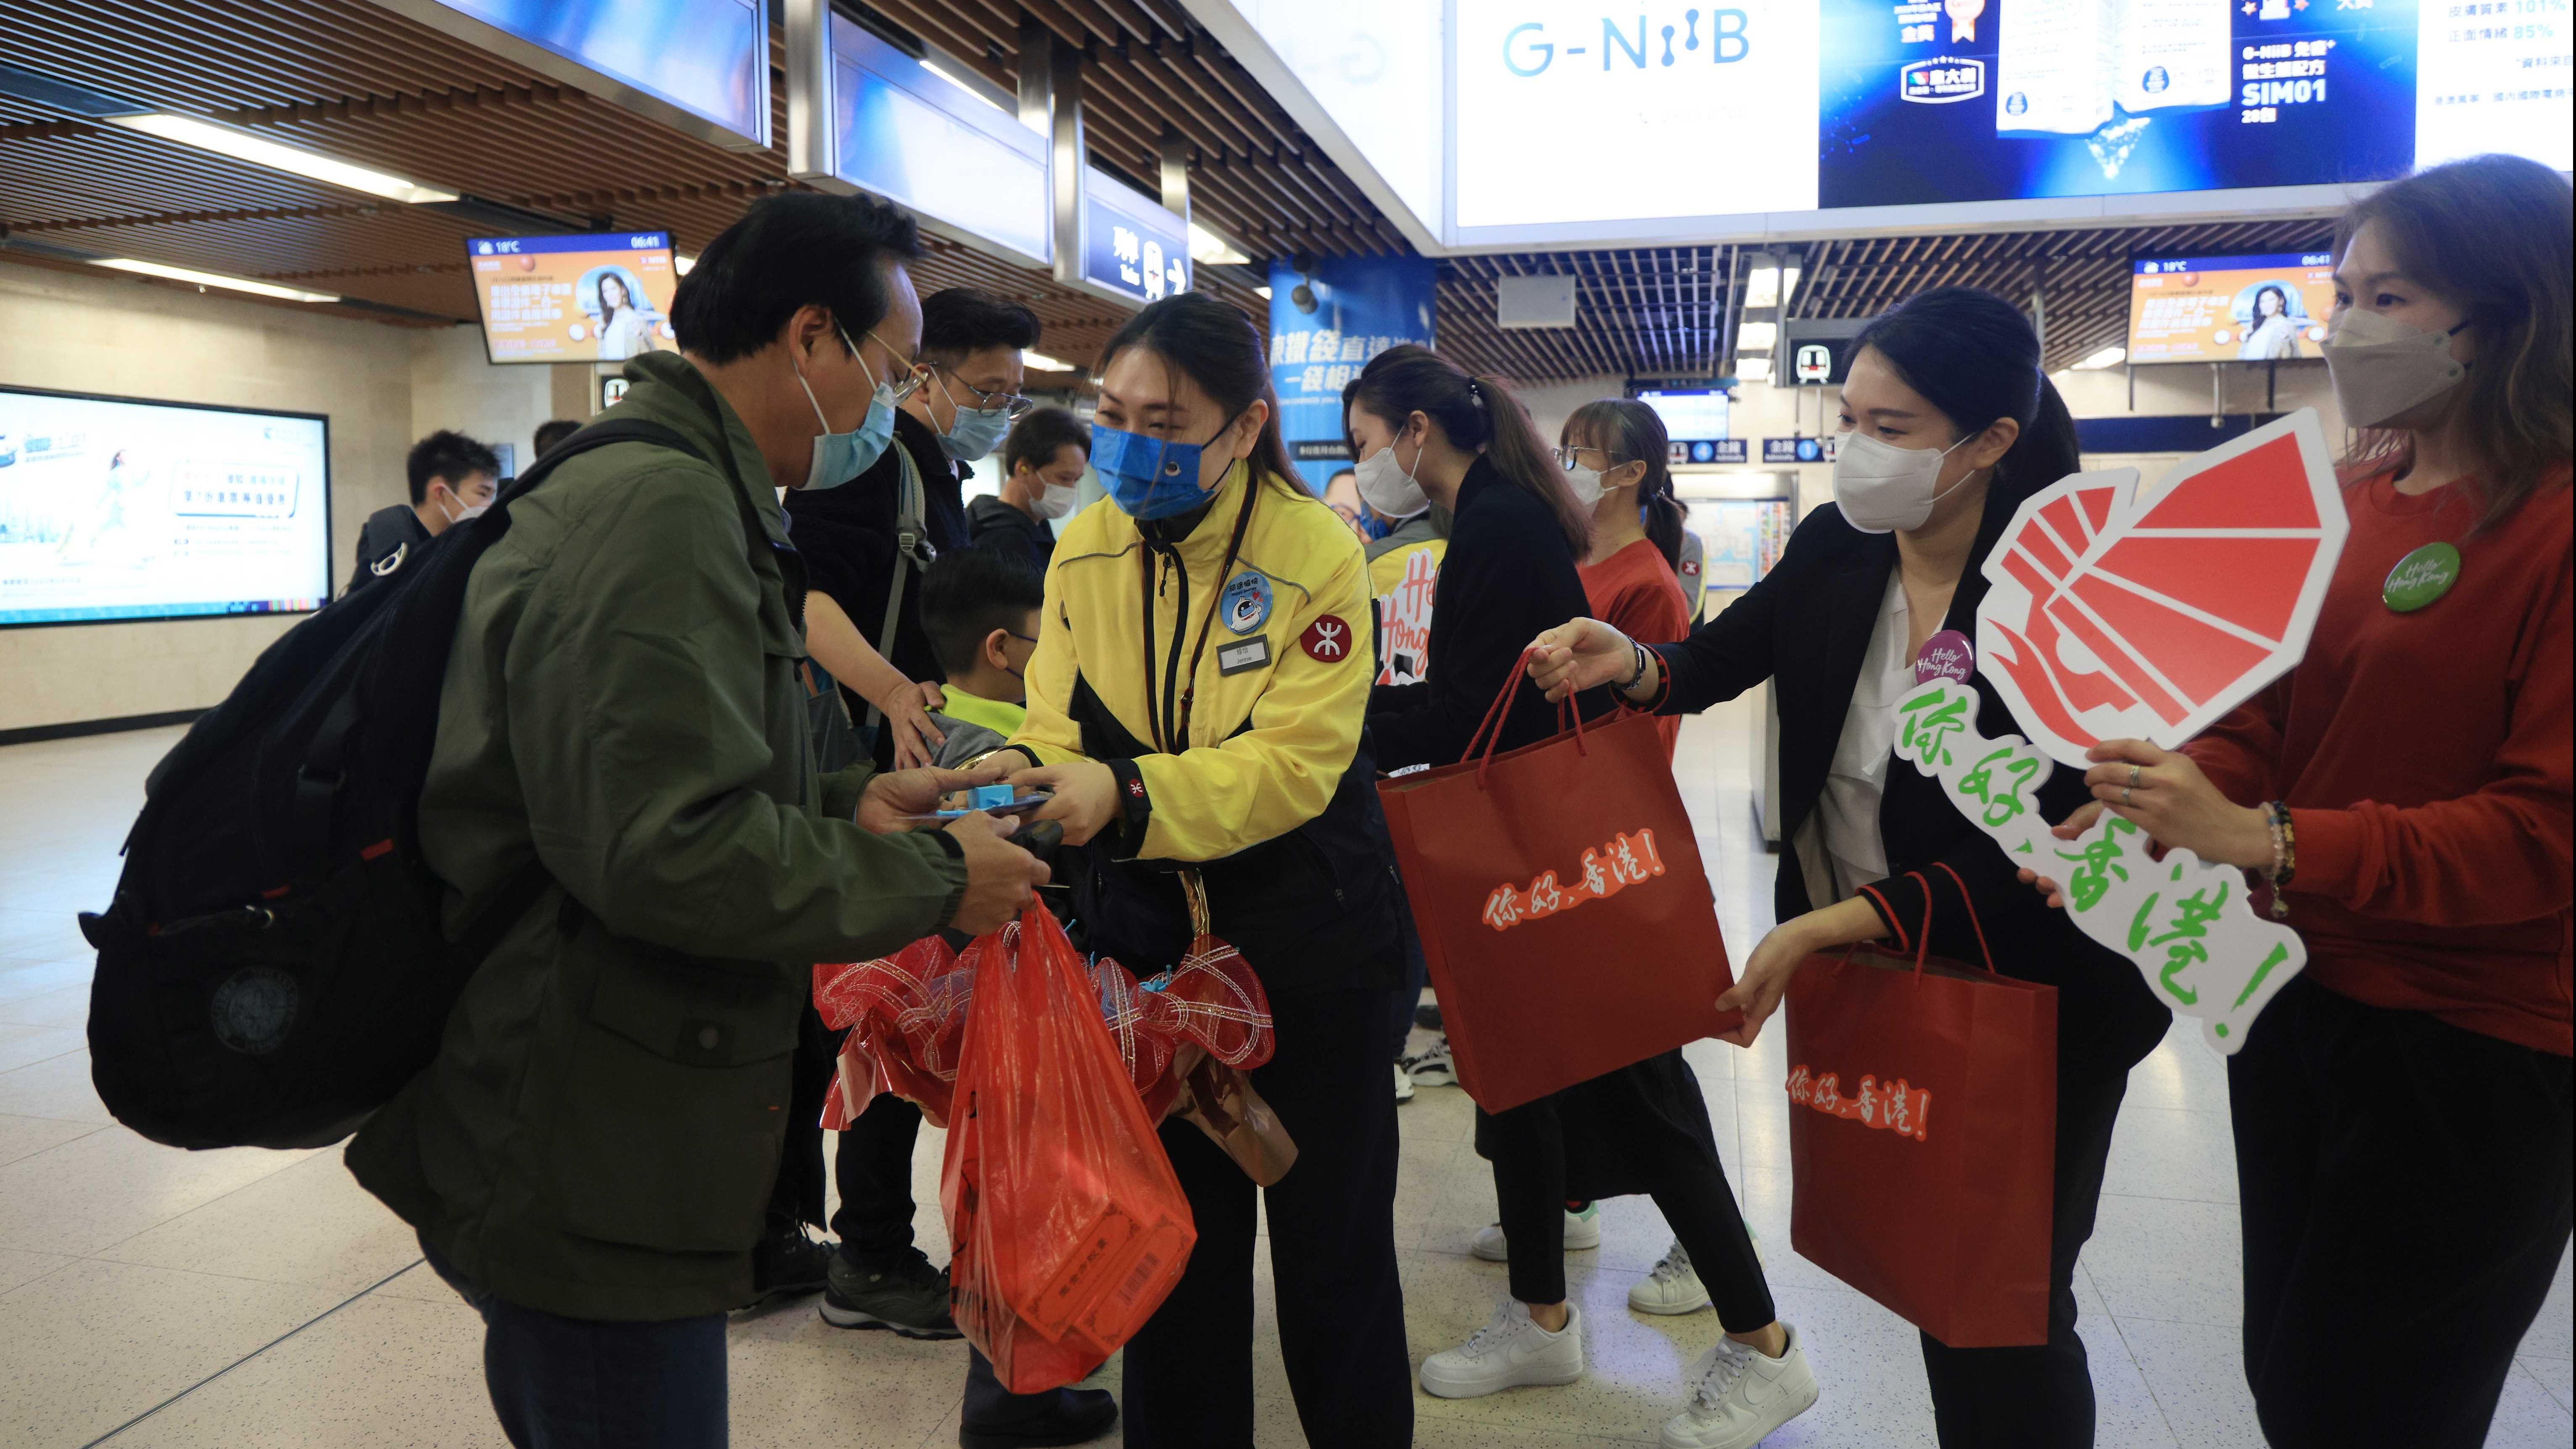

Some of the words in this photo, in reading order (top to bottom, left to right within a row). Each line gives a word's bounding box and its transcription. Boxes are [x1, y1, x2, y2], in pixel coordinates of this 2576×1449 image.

[2514, 24, 2554, 39] 85%
[2241, 79, 2326, 106] SIM01
[631, 236, 659, 249] 06:41
[1697, 445, 1708, 457] 4
[1804, 443, 1811, 456] 1
[2405, 559, 2445, 578] Hello
[1229, 577, 1258, 592] 旅途愉快
[2387, 576, 2417, 593] Hong
[2418, 572, 2449, 588] Kong
[1381, 598, 1430, 677] Hong
[1237, 646, 1248, 655] 珍怡
[1931, 648, 1963, 663] Hello
[1917, 658, 1942, 676] Hong
[1942, 661, 1966, 680] Kong
